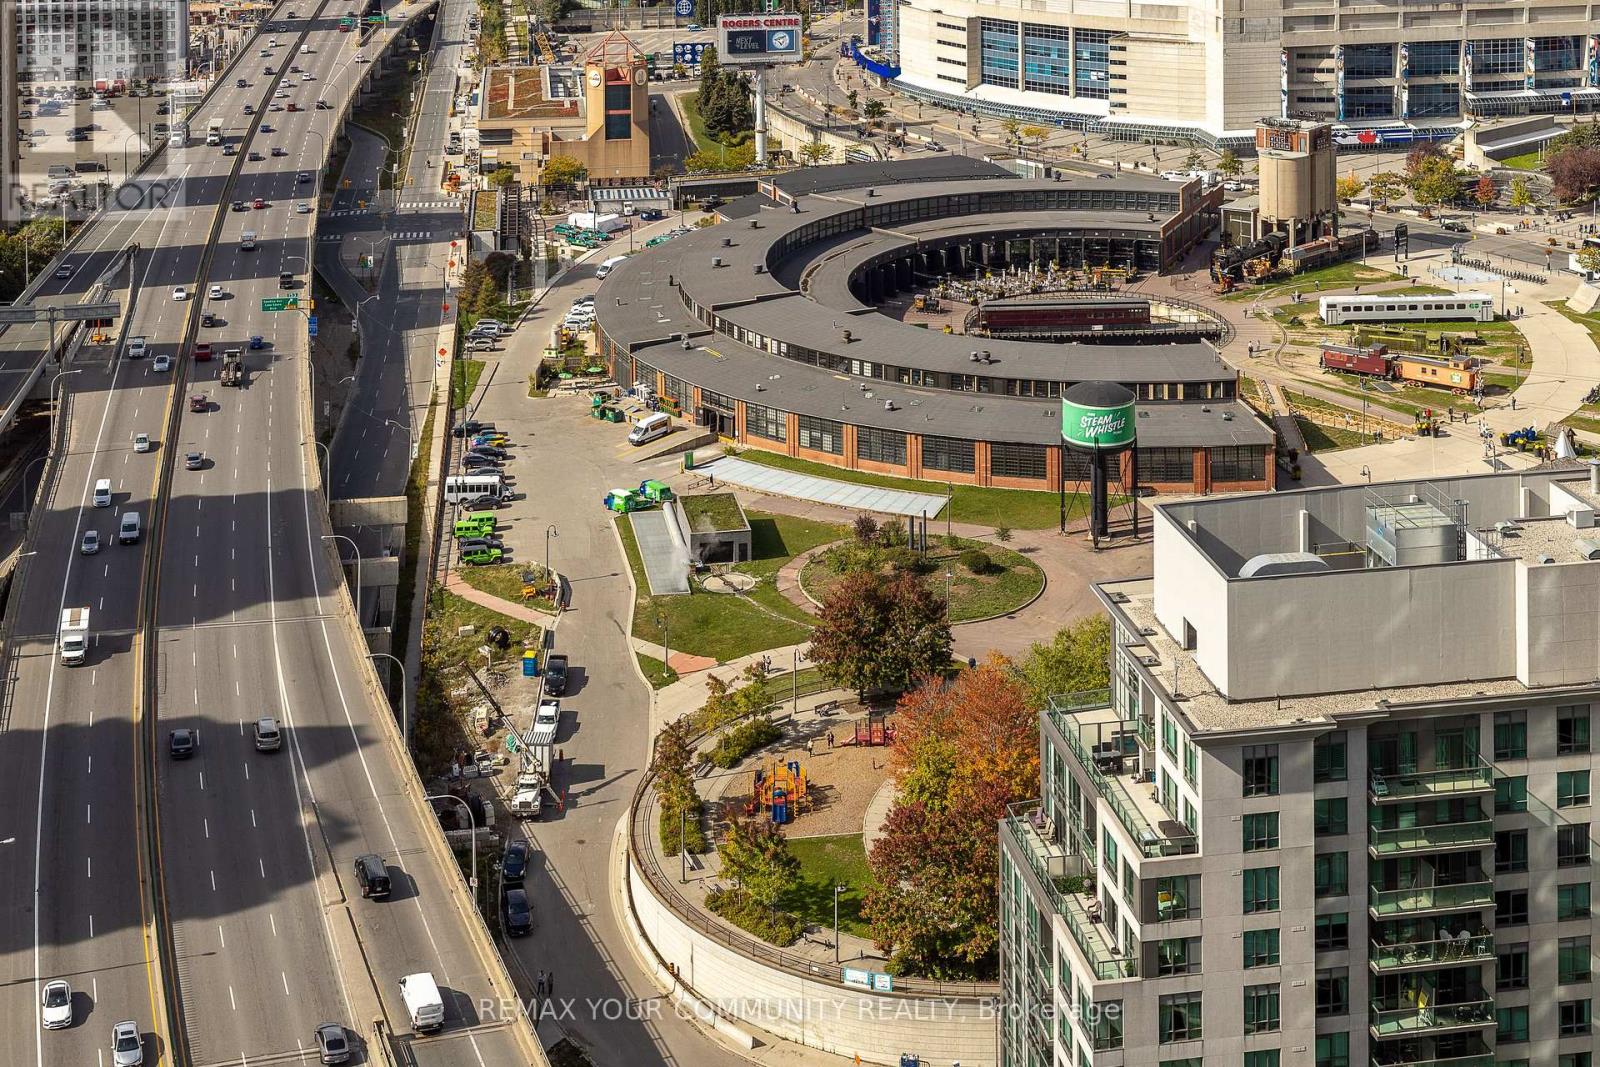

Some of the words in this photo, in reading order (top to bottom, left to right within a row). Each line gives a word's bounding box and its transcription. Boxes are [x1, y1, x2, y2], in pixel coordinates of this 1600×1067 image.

[722, 19, 760, 28] ROGERS
[763, 18, 800, 27] CENTRE
[1080, 414, 1113, 428] STEAM
